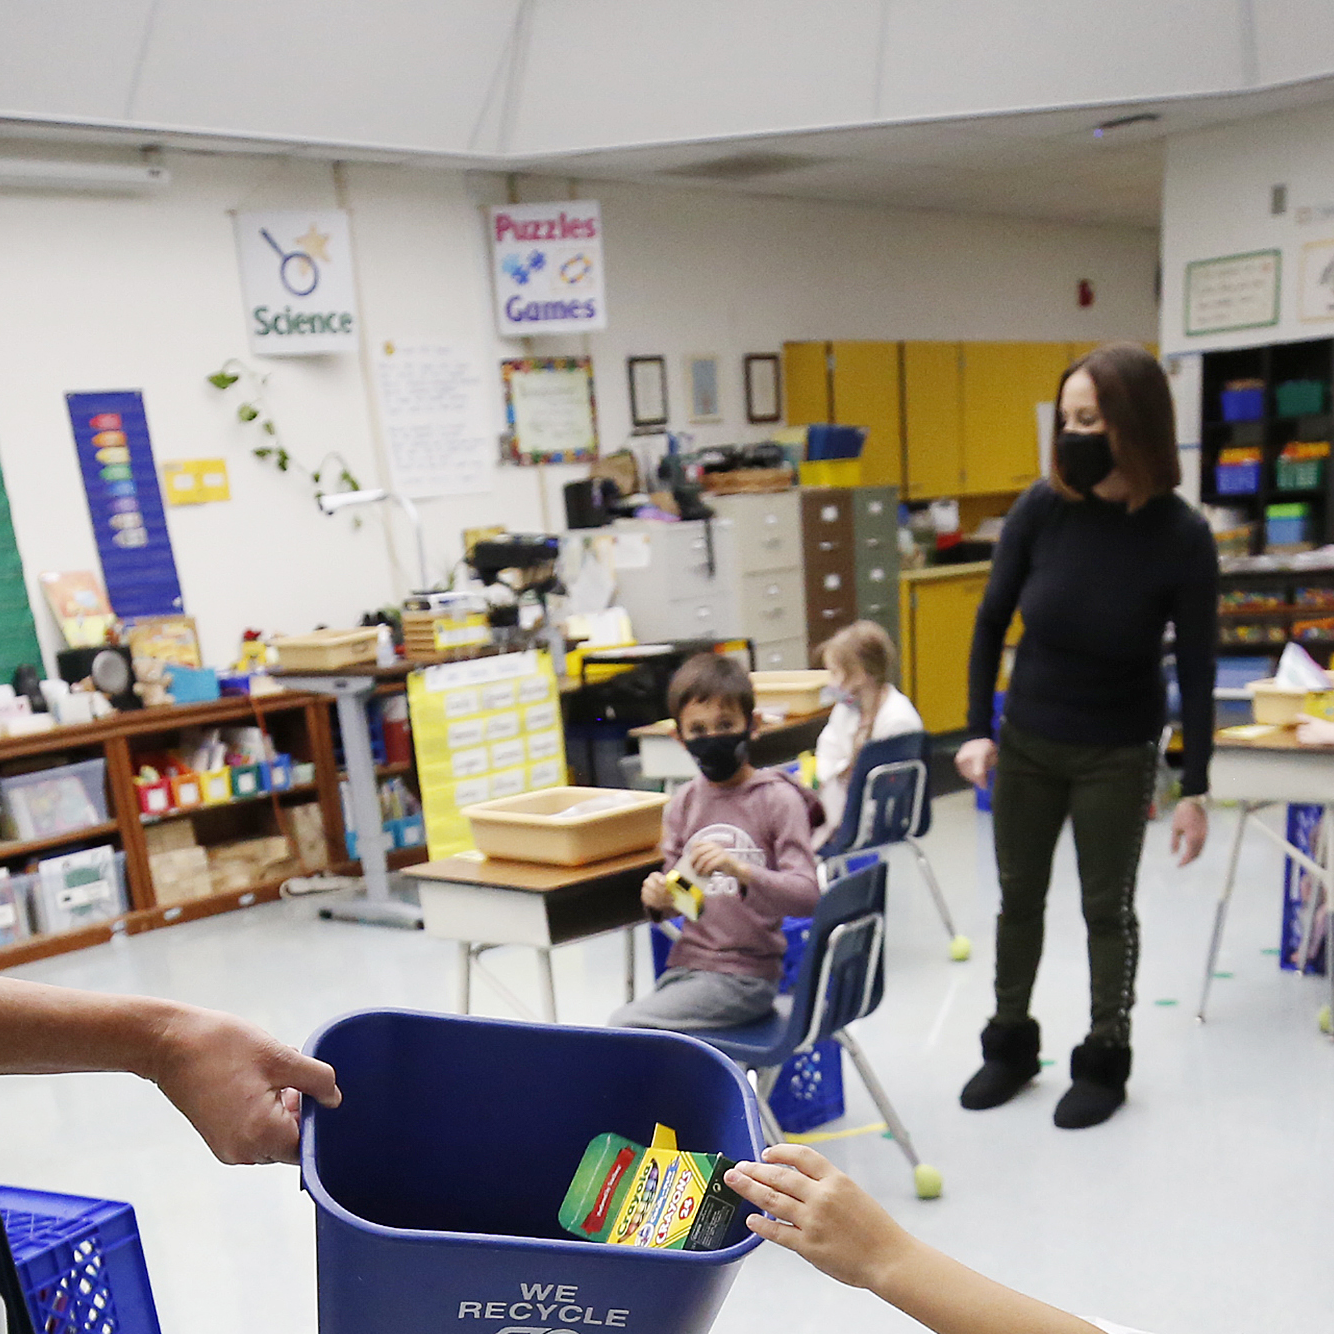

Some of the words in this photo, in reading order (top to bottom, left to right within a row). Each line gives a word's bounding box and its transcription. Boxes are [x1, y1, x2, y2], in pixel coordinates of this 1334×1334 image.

[495, 211, 596, 242] Puzzles
[254, 305, 353, 336] Science
[506, 294, 596, 322] Games
[617, 1165, 651, 1236] Crayola
[655, 1169, 693, 1245] CRAYONS
[680, 1197, 693, 1218] 24
[520, 1283, 578, 1303] WE
[458, 1301, 630, 1327] RECYCLE
